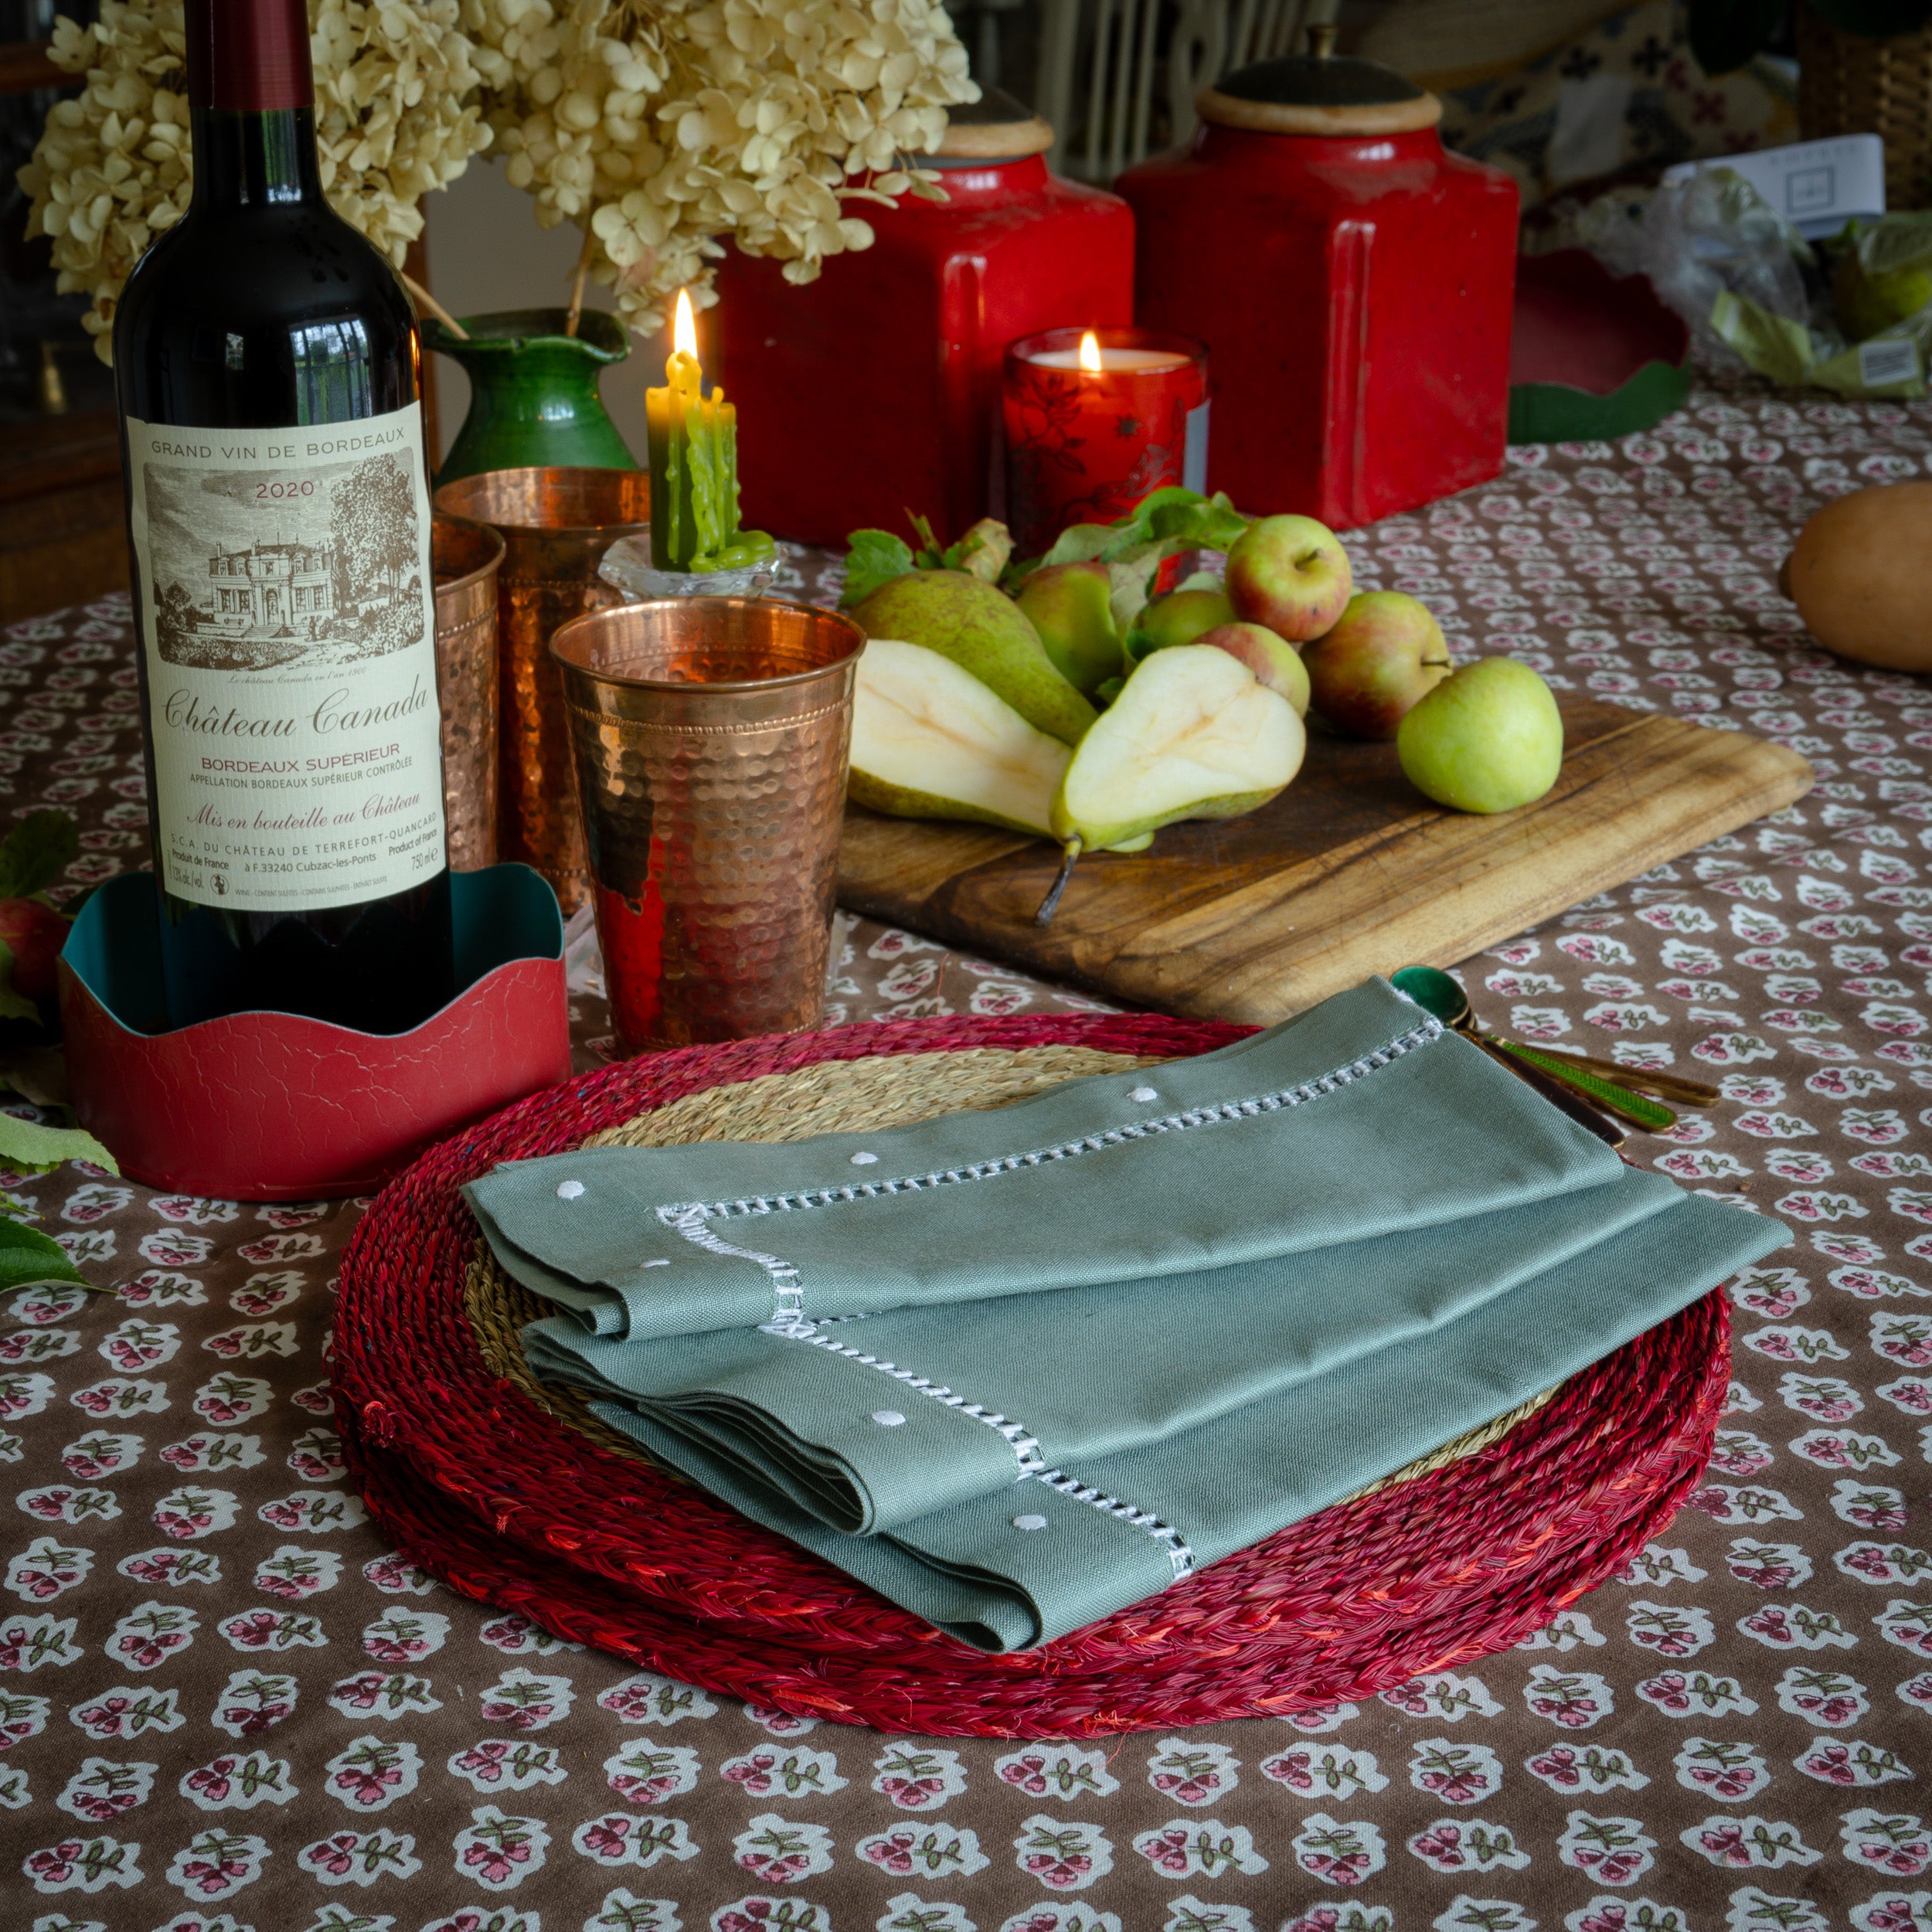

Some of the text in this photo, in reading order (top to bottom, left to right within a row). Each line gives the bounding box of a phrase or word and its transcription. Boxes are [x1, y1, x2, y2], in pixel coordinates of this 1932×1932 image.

[151, 427, 405, 459] GRAND VIN DE BORDEAUX
[256, 481, 314, 499] 2020
[277, 672, 312, 684] Canada
[162, 673, 428, 737] Château Canada
[190, 755, 413, 789] APPELLATION BORDEAUX SUPÉRIEUR CONTRÔLÉE
[202, 743, 400, 774] BORDEAUX SUPÉRIEUR
[186, 793, 420, 830] Mis en bouteille au Château
[170, 811, 437, 856] S.C.A. DU CHÂTEAU DE TERREFORT-QUANCARD
[388, 839, 414, 856] Product
[415, 834, 422, 847] of
[194, 855, 202, 866] de
[204, 856, 230, 871] France
[244, 862, 250, 872] à
[296, 852, 377, 872] Cubzac-les-Ponts
